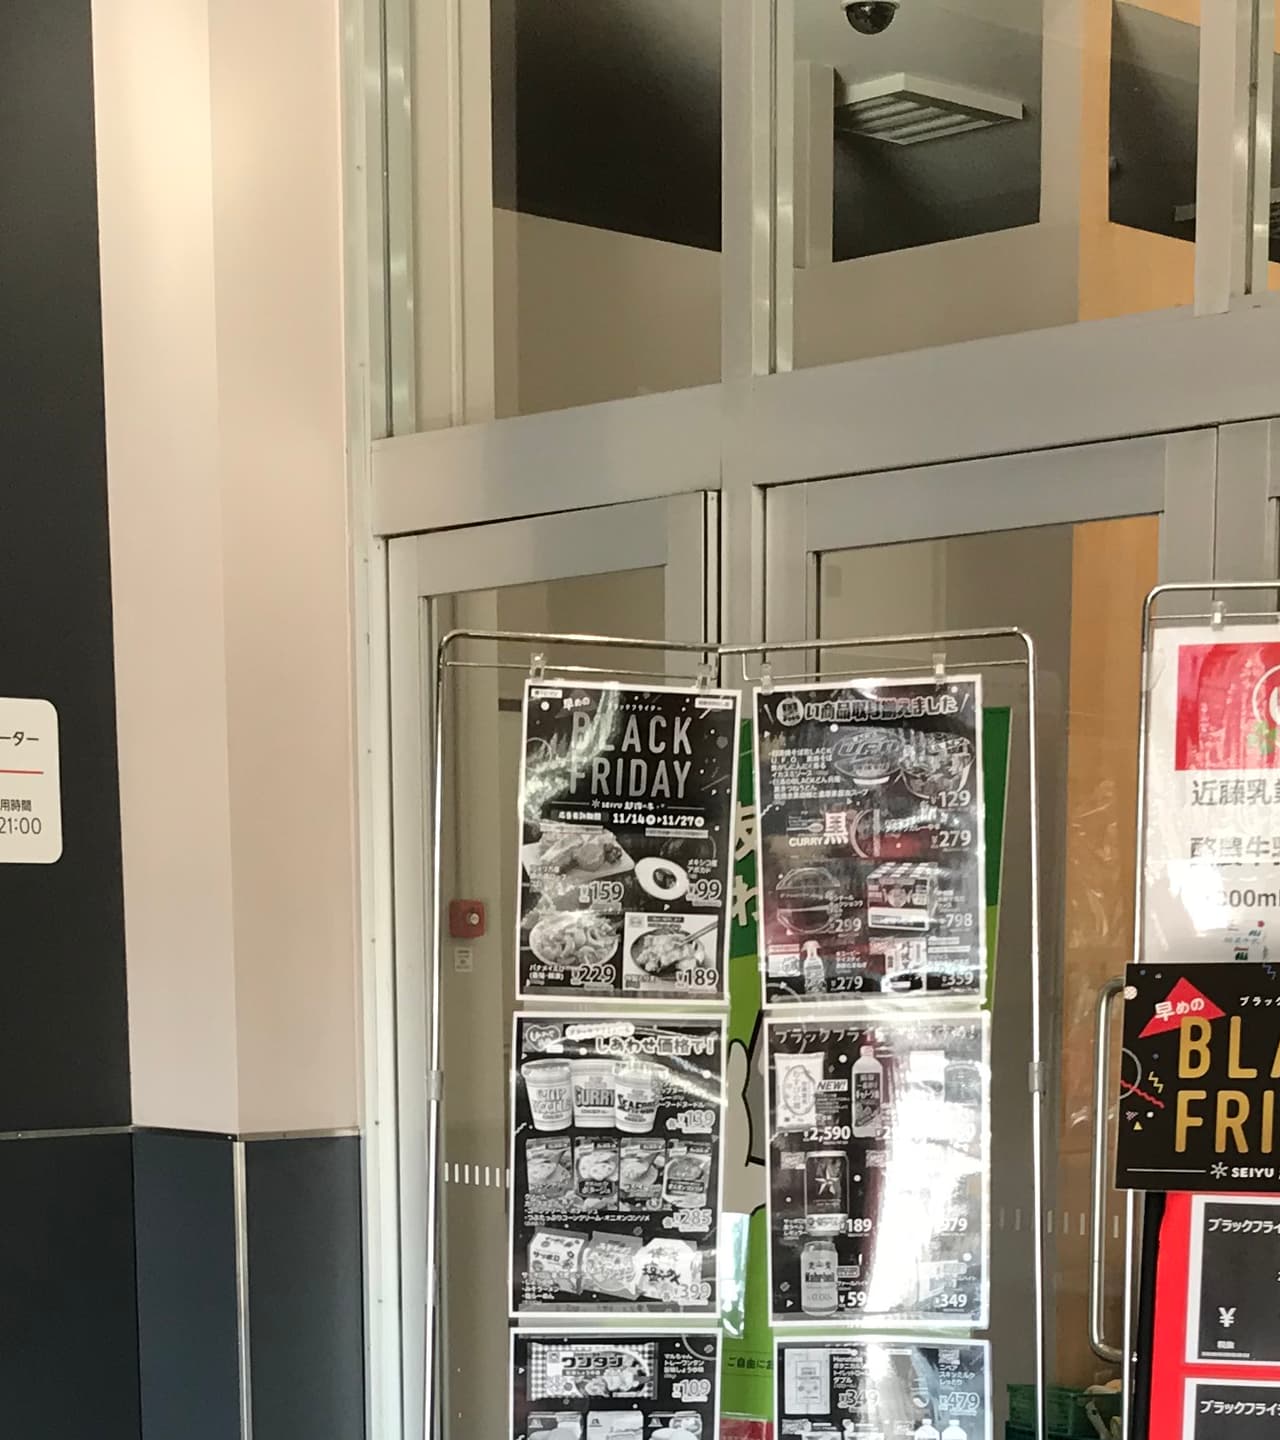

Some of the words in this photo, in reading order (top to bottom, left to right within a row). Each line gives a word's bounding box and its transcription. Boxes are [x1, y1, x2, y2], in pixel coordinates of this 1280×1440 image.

[1155, 998, 1205, 1022] 早めの
[1231, 1166, 1275, 1178] SEIYU
[1219, 1307, 1236, 1327] ¥
